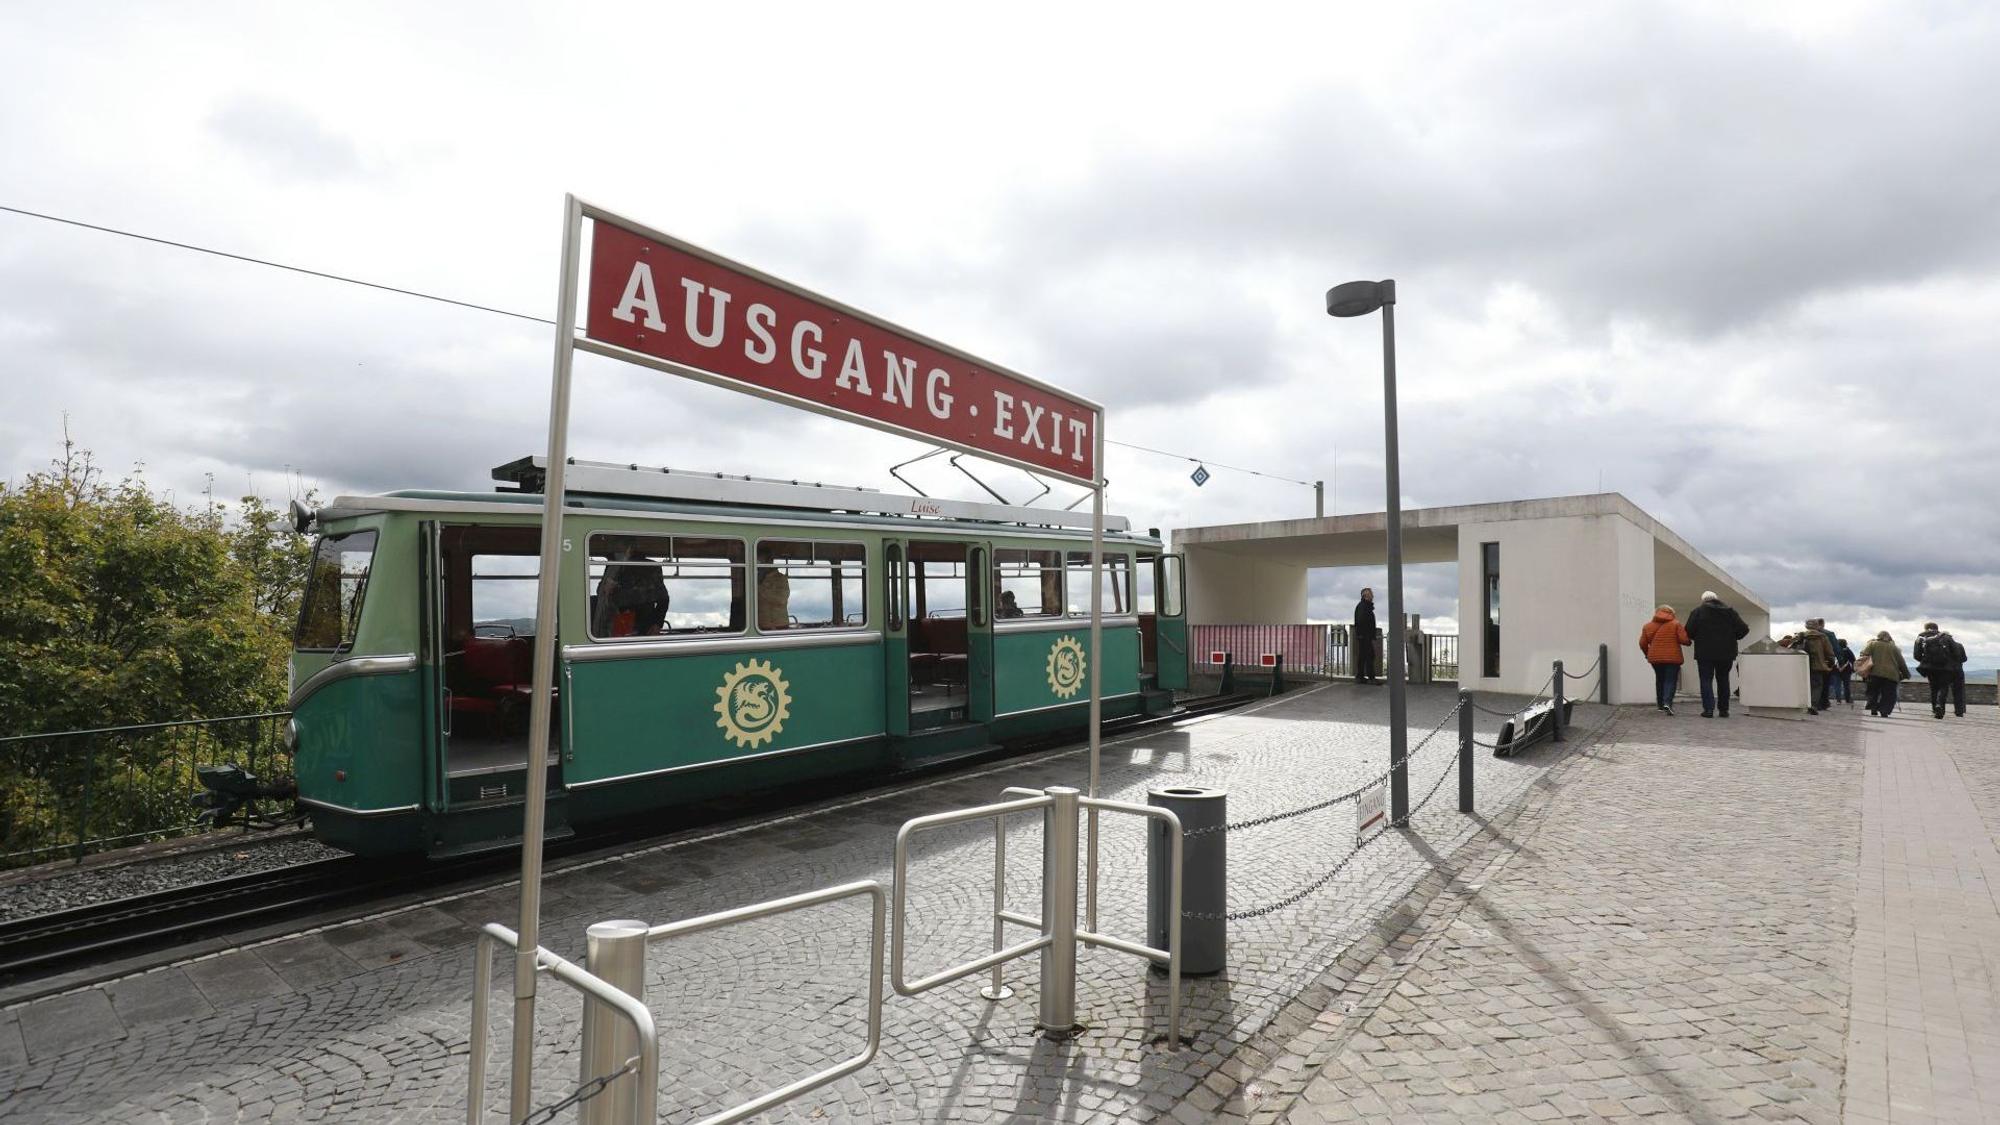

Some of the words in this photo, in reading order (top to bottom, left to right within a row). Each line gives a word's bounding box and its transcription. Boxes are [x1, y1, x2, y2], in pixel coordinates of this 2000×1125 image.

[611, 260, 955, 419] AUSGANG
[992, 390, 1087, 462] EXIT
[911, 499, 940, 514] Luise
[562, 538, 572, 552] 5
[1359, 794, 1386, 821] EINGANG
